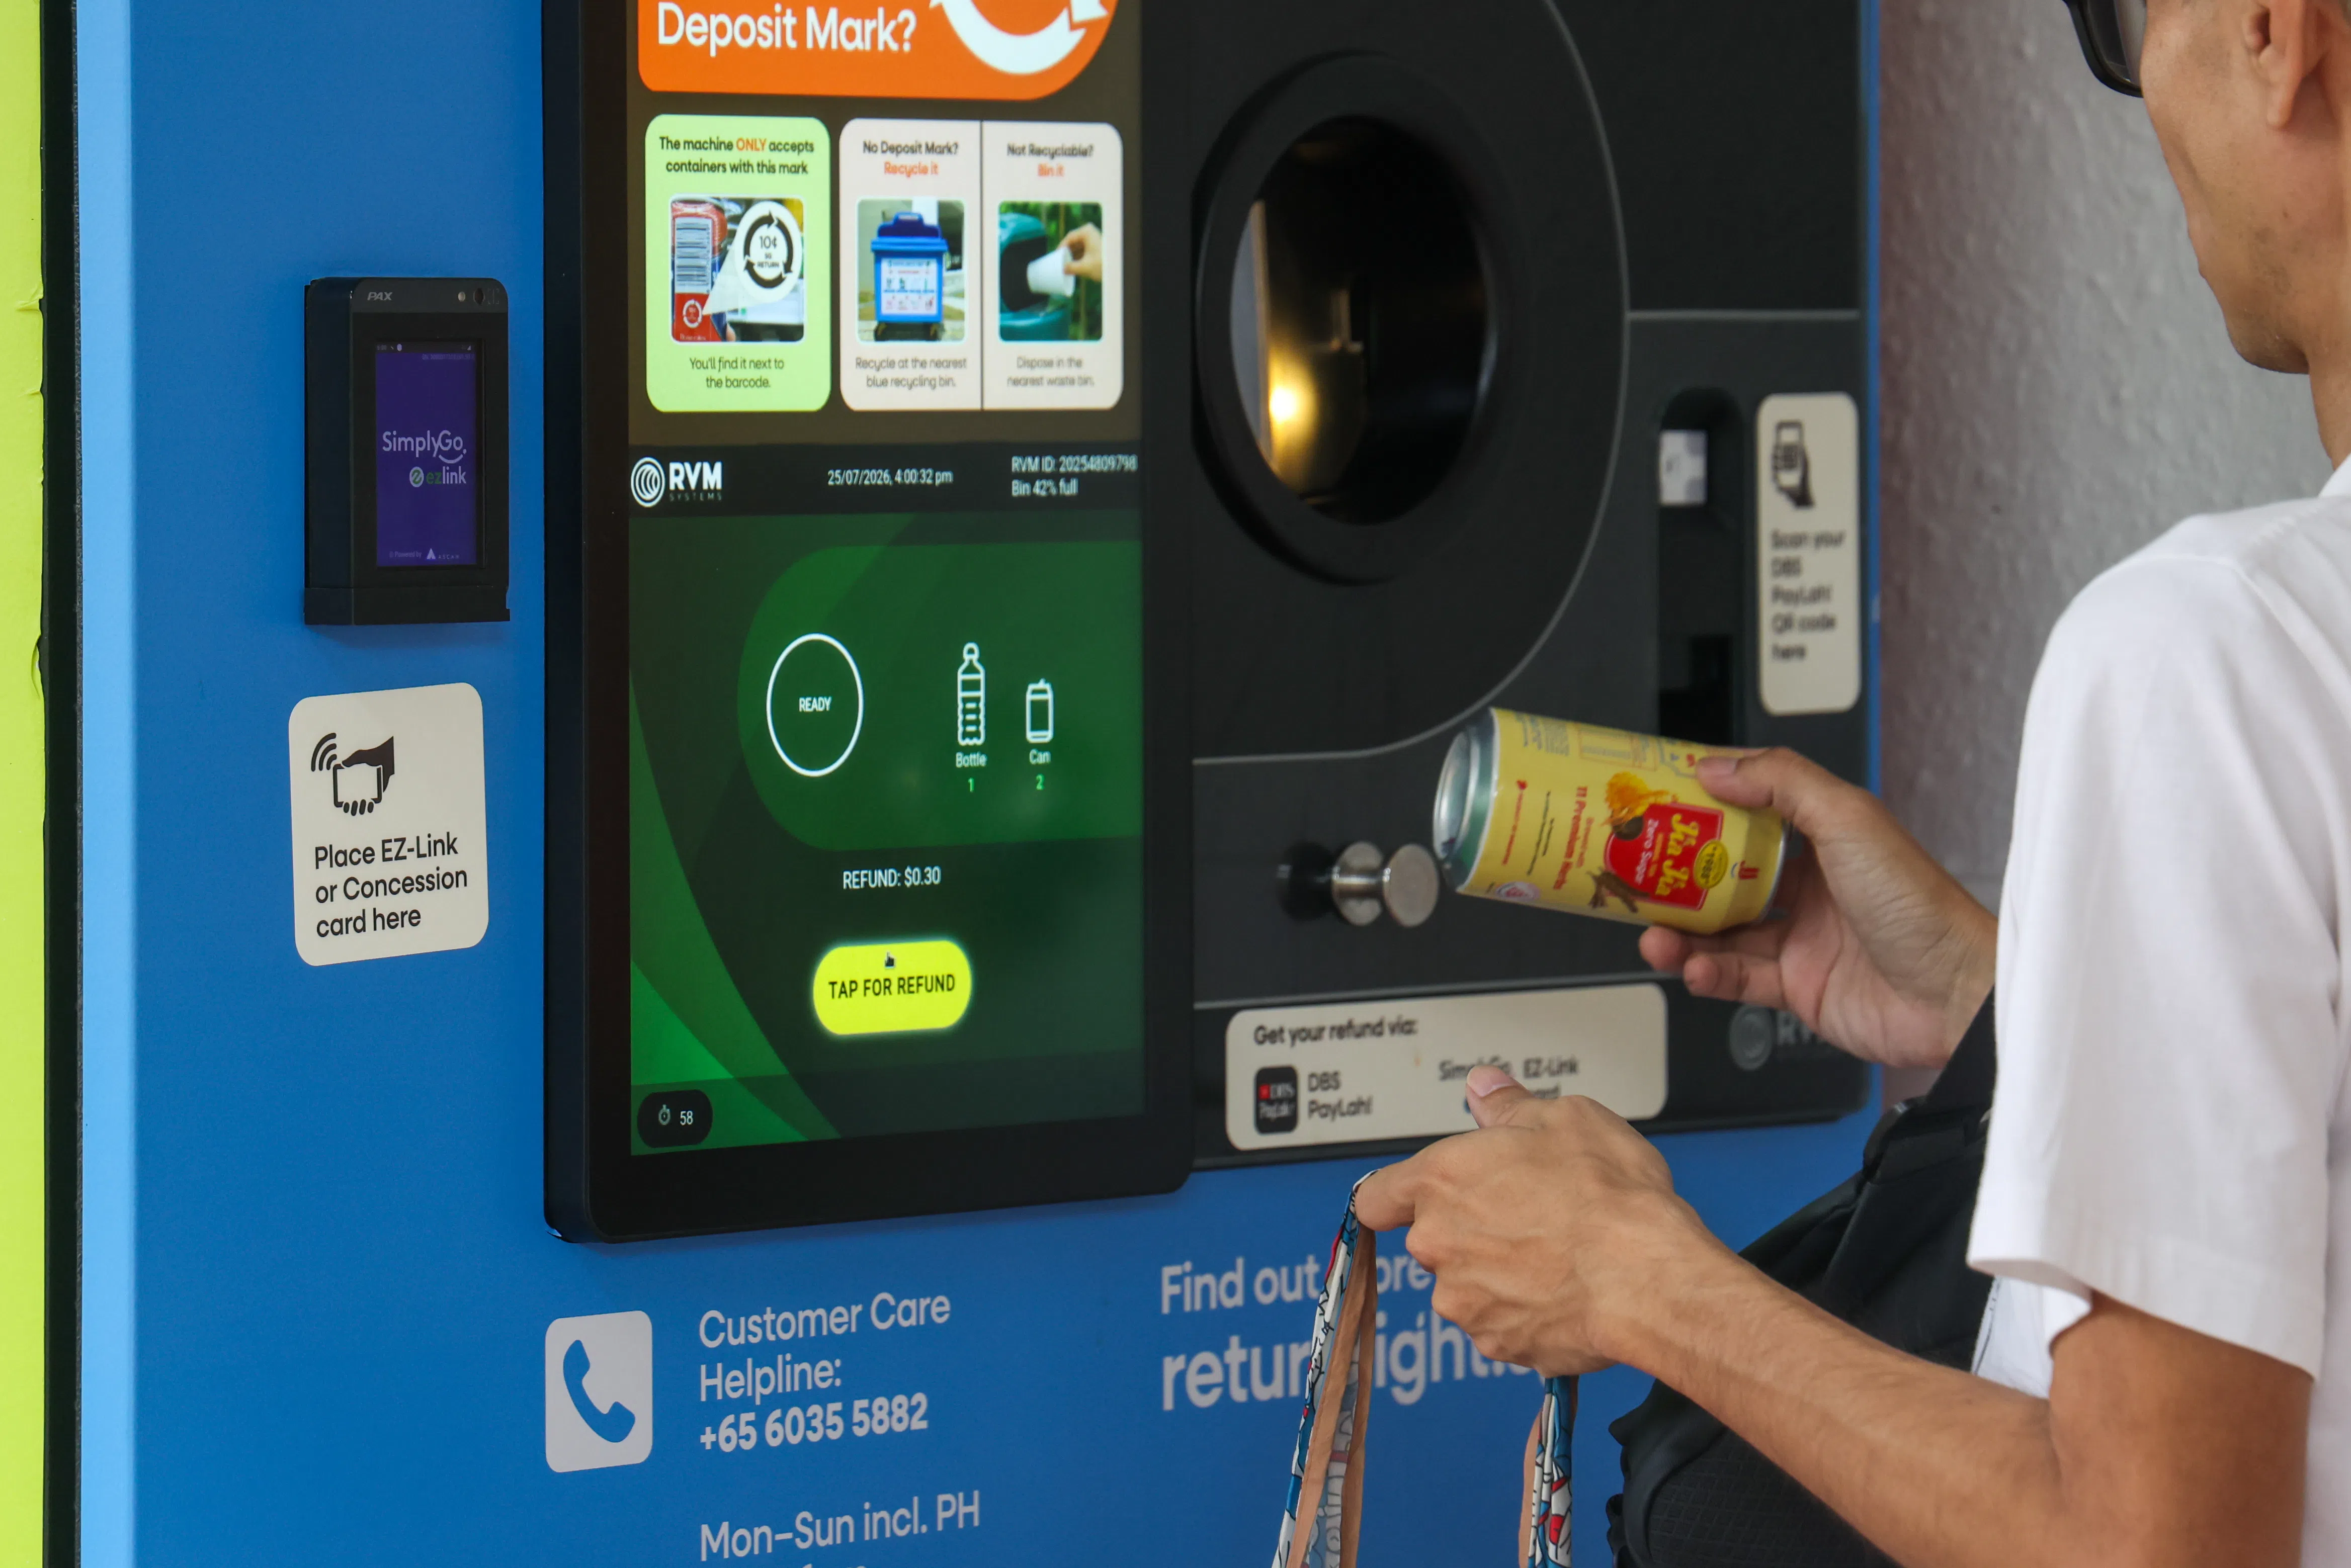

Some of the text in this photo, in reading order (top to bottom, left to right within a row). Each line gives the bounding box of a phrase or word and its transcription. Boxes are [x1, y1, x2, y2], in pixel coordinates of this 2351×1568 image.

[658, 2, 916, 56] Deposit Mark?
[659, 136, 814, 155] The machine ONLY accepts
[863, 140, 958, 157] No Deposit Mark?
[1007, 143, 1094, 160] Not Recyclable?
[665, 158, 808, 174] containers with this mark
[884, 161, 939, 178] Recycle it
[1038, 163, 1064, 177] Bin it
[367, 292, 393, 301] PAX
[690, 357, 785, 373] You'll find it next to
[856, 357, 967, 372] Recycle at the nearest
[706, 376, 771, 388] the barcode.
[866, 375, 956, 390] blue recycling bin.
[1012, 456, 1040, 473] RVM
[426, 466, 466, 484] ezlink
[669, 462, 722, 490] RVM
[828, 468, 953, 486] 25/07/2026, 4:00:32 pm
[1012, 478, 1078, 496] Bin 42% full
[669, 492, 722, 501] SYSTEMS
[799, 696, 831, 712] READY
[956, 752, 987, 767] Bottle
[1029, 749, 1051, 764] Can
[968, 777, 974, 793] 1
[1036, 774, 1044, 790] 2
[315, 831, 458, 869] Place EZ-Link
[316, 866, 467, 903] or Concession
[843, 865, 941, 889] REFUND: $0.30
[316, 908, 421, 937] card here
[828, 974, 955, 999] TAP FOR REFUND
[1254, 1025, 1285, 1044] Get
[1289, 1026, 1325, 1048] your
[1329, 1017, 1384, 1040] refund
[1308, 1071, 1341, 1092] DBS
[680, 1109, 693, 1125] 58
[1161, 1255, 1433, 1314] Find out ore
[700, 1292, 951, 1348] Customer Care
[701, 1353, 842, 1406] Helpline:
[700, 1392, 928, 1452] +65 6035 5882
[864, 1496, 928, 1541] incl.
[937, 1490, 980, 1531] PH
